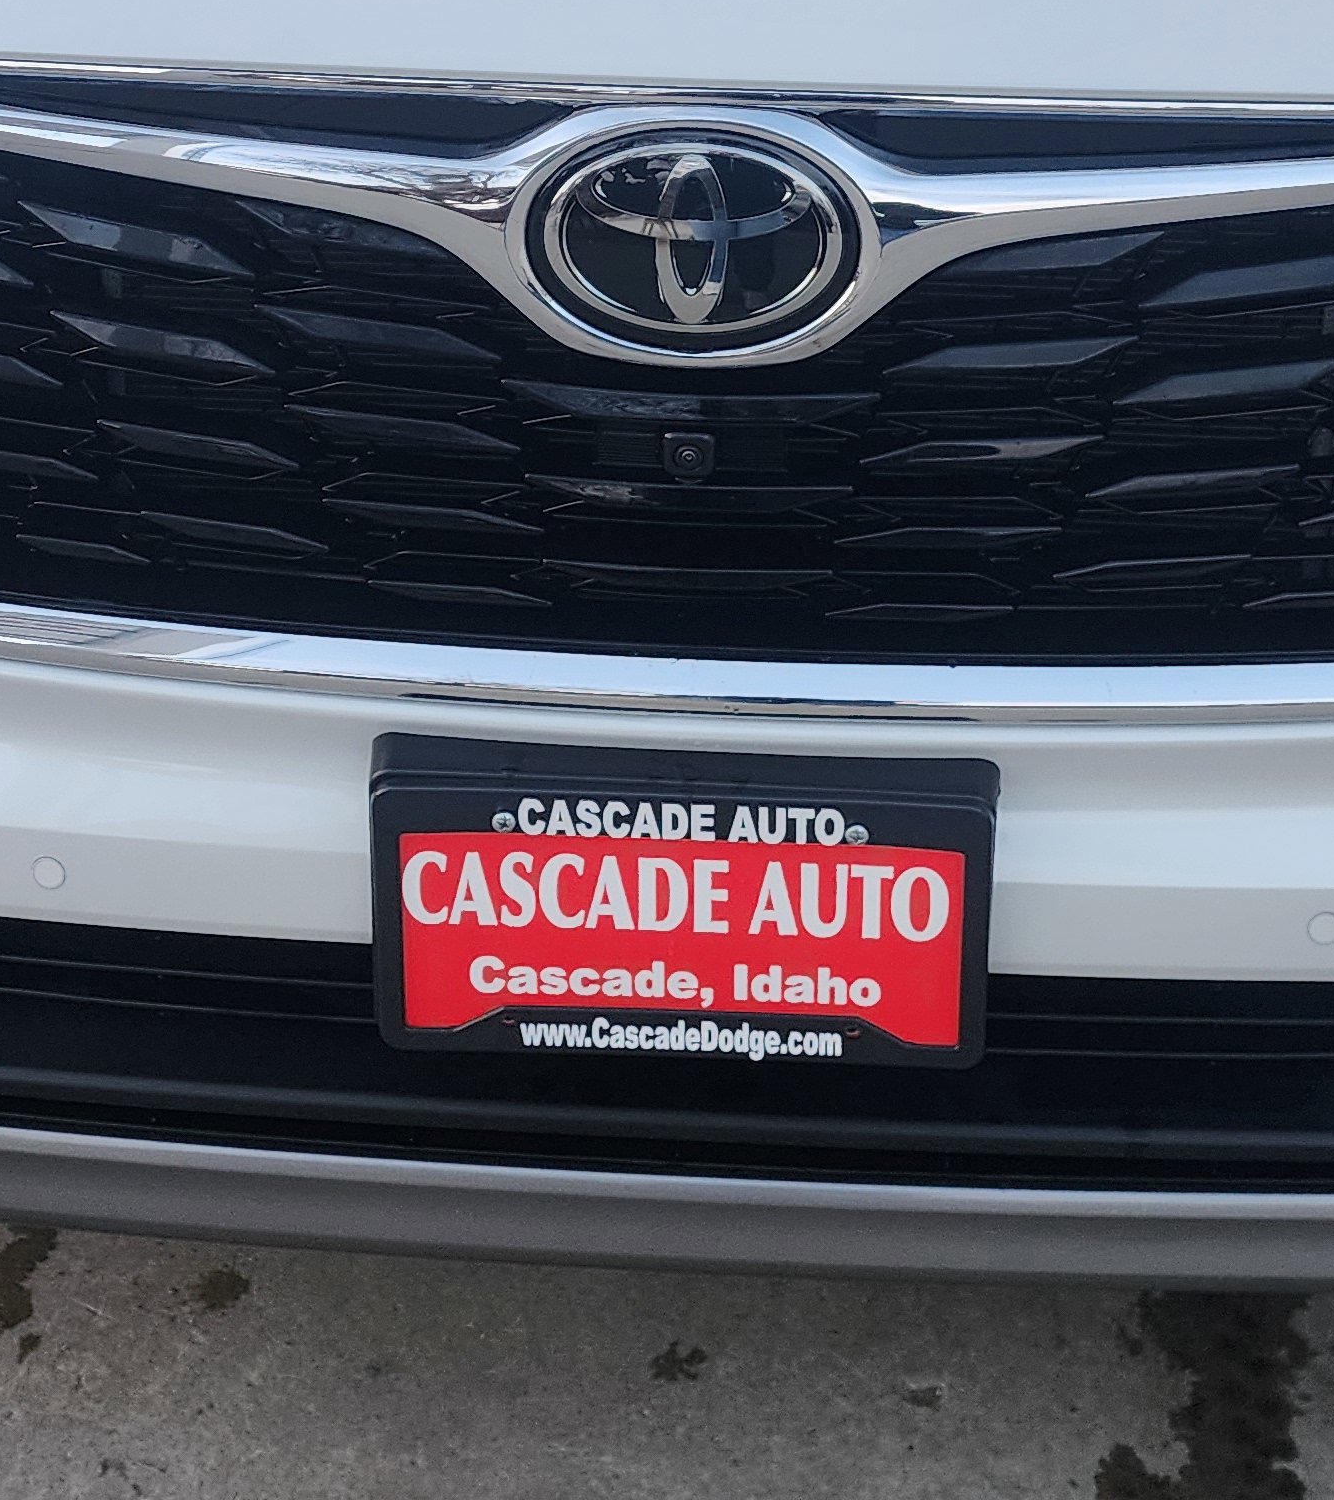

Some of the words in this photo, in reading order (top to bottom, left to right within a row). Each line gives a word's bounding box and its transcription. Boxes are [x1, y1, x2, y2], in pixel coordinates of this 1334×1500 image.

[516, 797, 717, 841] CASCADE
[727, 804, 846, 847] AUTO
[401, 850, 730, 934] CASCADE
[748, 859, 950, 942] AUTO
[468, 955, 715, 1008] Cascade,
[733, 963, 882, 1007] Idaho
[519, 1016, 843, 1062] www.CascadeDodge.com
